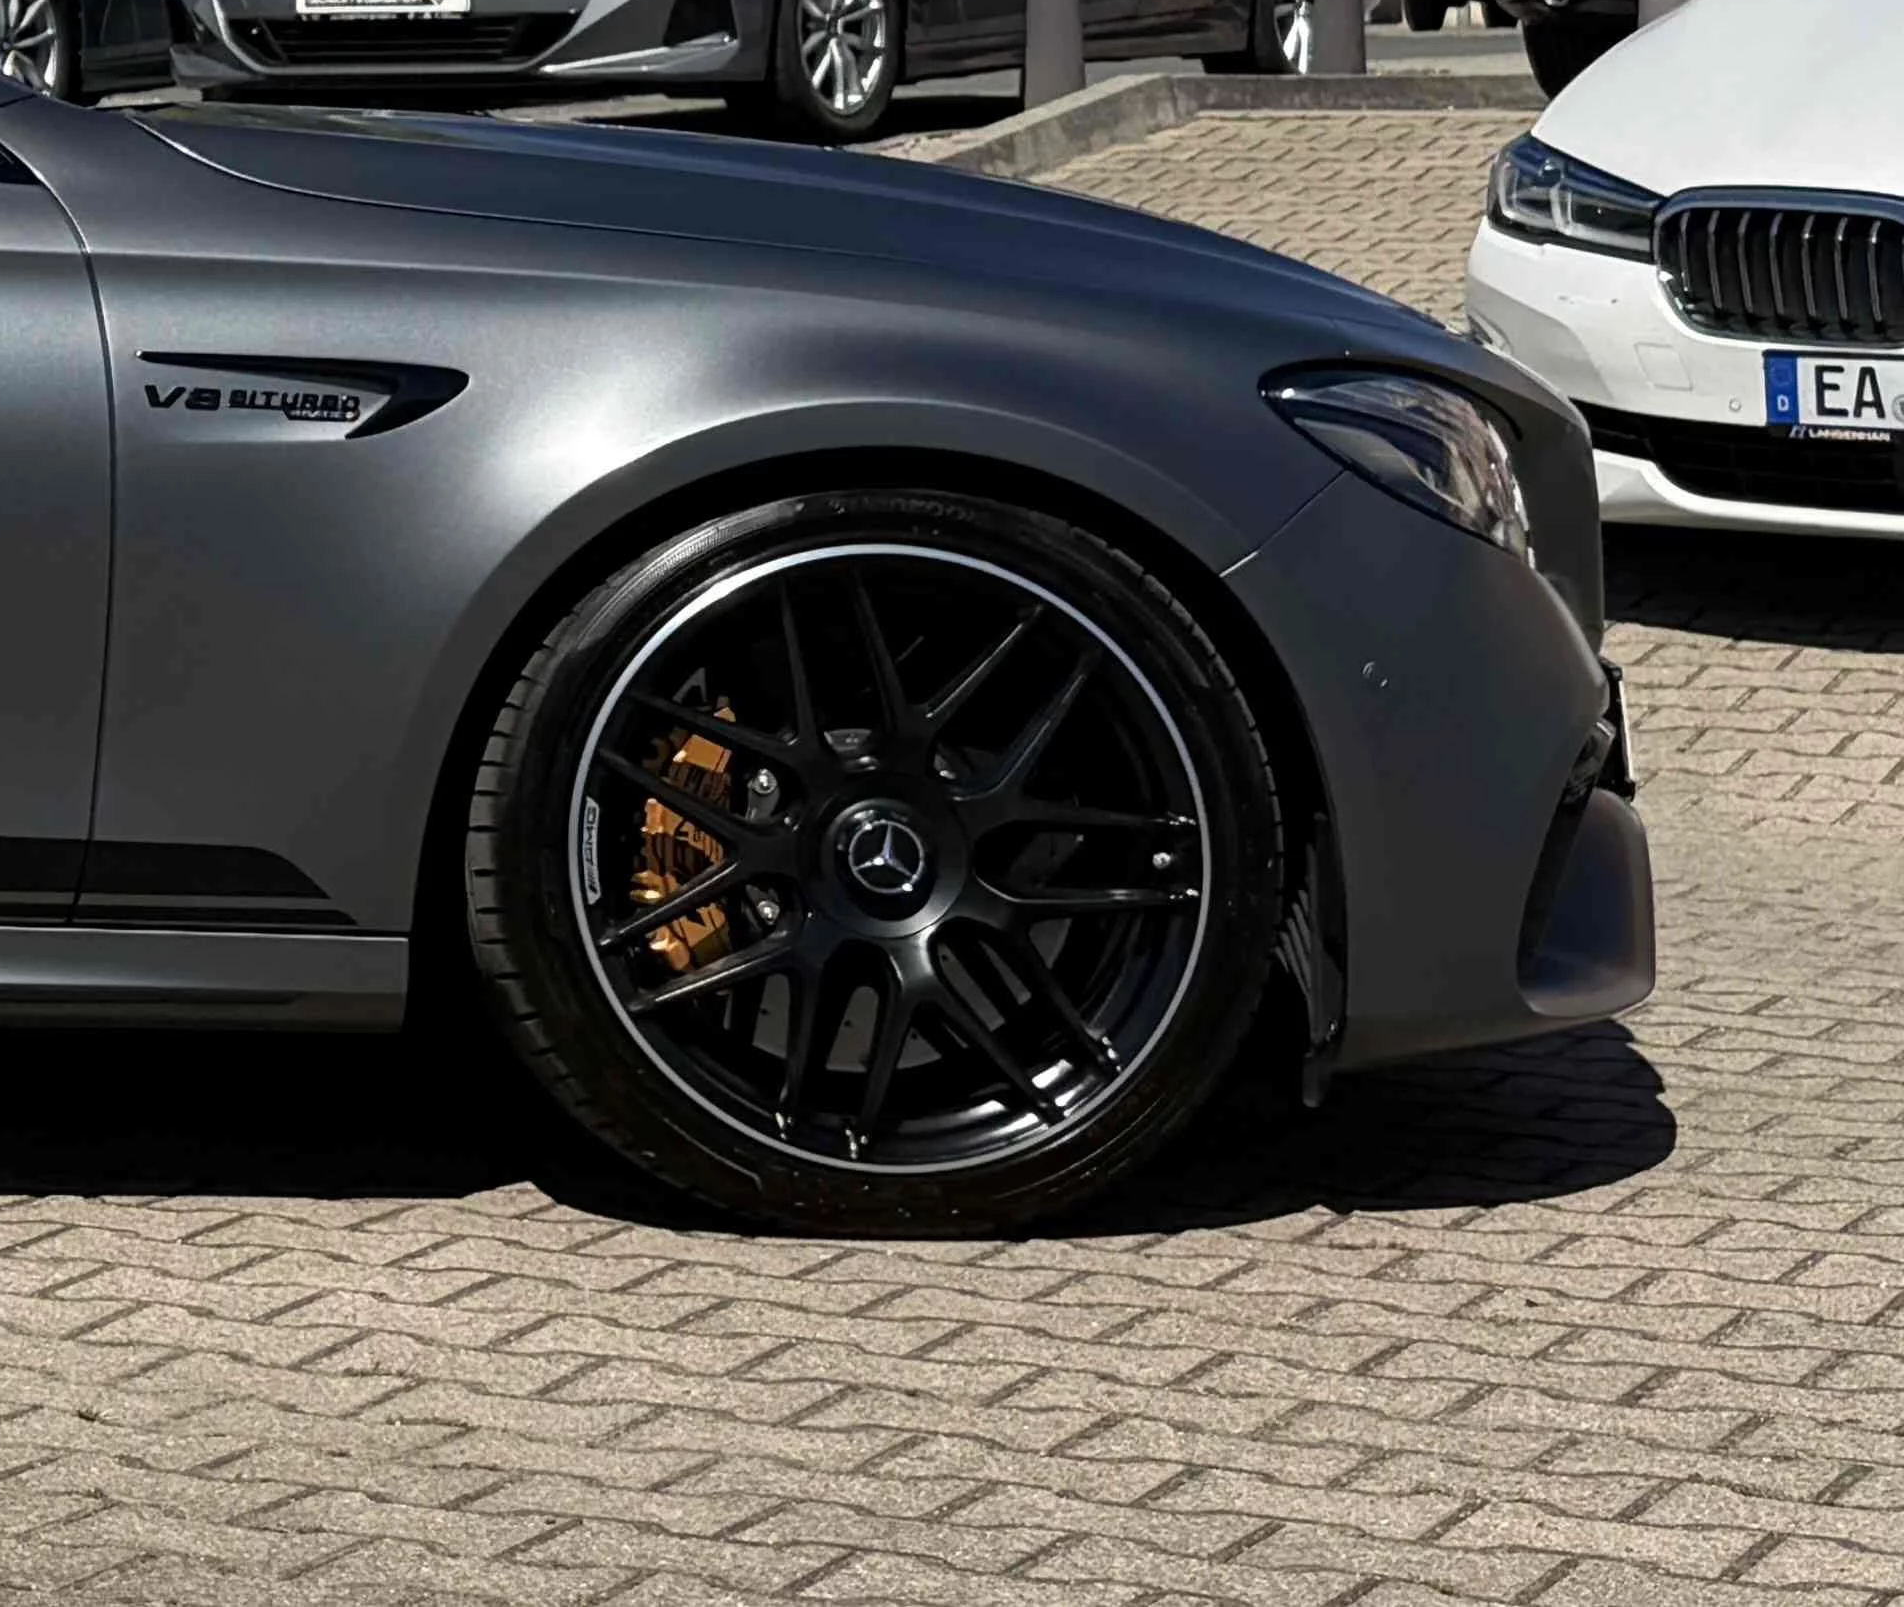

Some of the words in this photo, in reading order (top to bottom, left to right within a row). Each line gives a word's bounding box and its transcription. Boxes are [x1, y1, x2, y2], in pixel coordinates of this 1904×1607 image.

[144, 384, 222, 411] V8
[228, 389, 360, 412] BITURBO
[1777, 394, 1789, 412] D
[1814, 364, 1887, 419] EA
